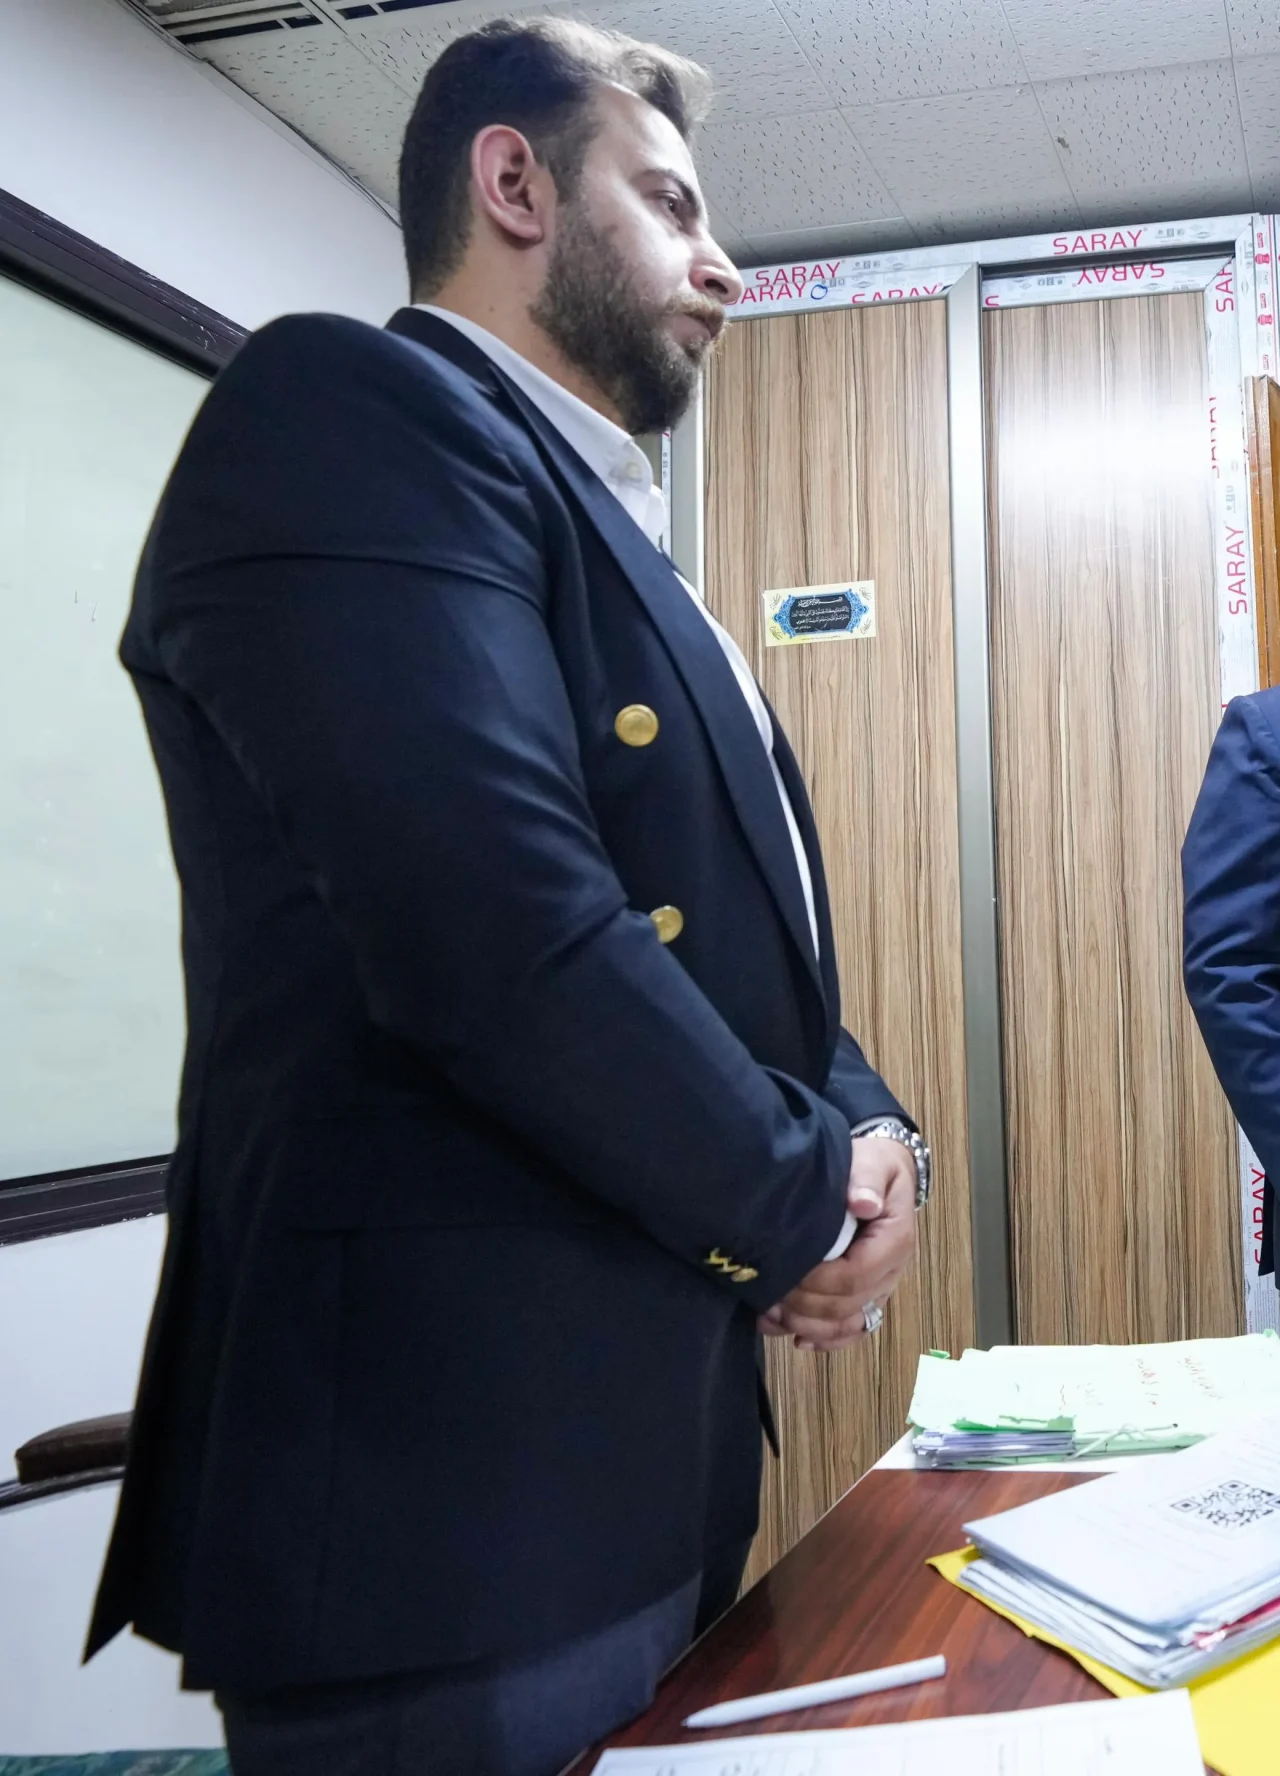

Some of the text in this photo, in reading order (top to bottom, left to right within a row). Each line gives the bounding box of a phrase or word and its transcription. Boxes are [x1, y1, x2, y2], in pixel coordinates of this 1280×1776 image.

[1053, 230, 1142, 254] SARAY
[756, 262, 840, 286] SARAY
[1077, 261, 1165, 285] SARAY
[1225, 525, 1247, 615] SARAY
